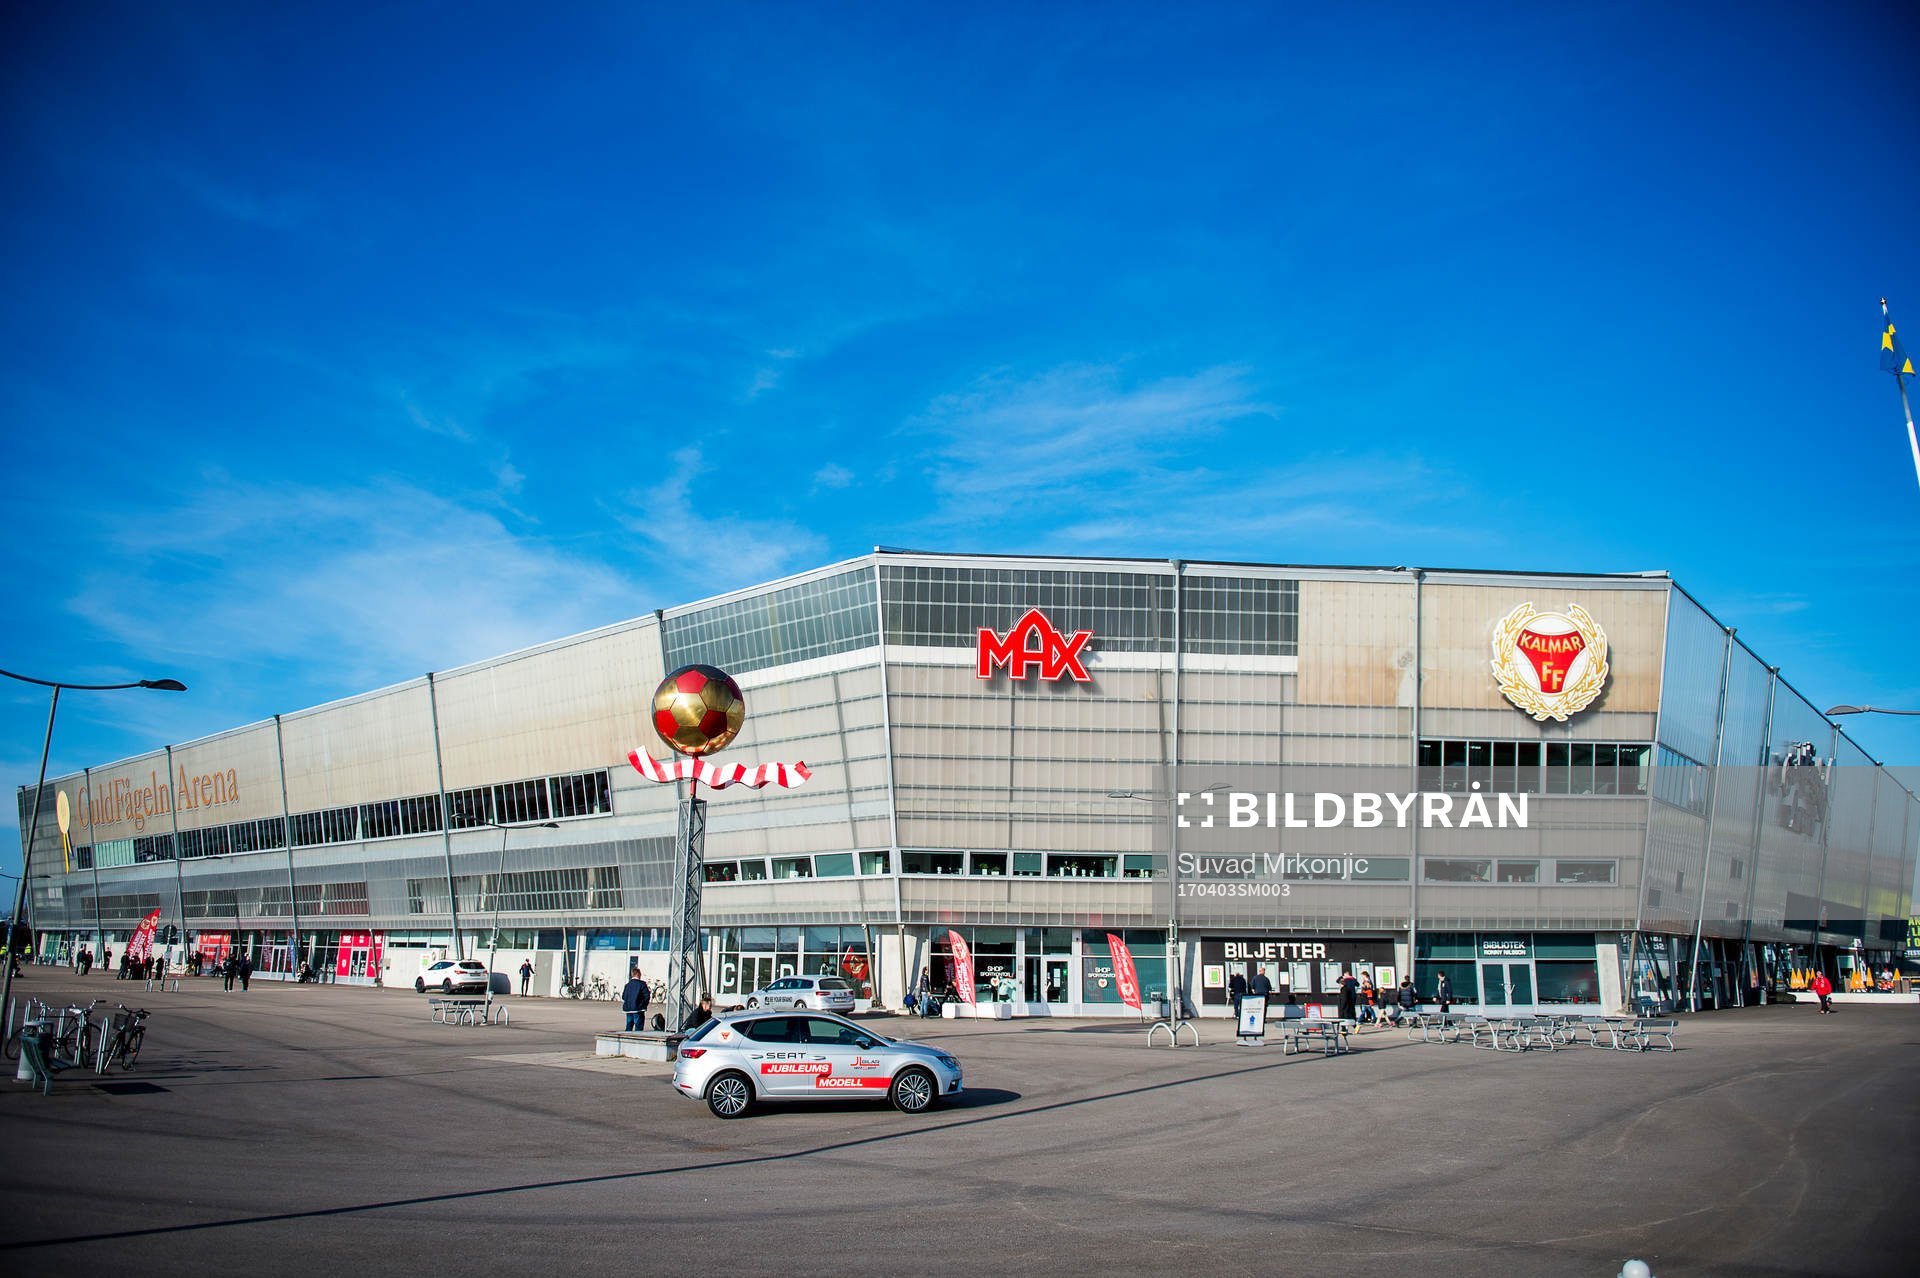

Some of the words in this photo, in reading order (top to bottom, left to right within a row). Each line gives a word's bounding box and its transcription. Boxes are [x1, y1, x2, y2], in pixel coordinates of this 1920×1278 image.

[976, 607, 1094, 682] MAX
[1520, 632, 1583, 653] KALMAR
[175, 763, 239, 811] Arena
[1224, 942, 1327, 959] BILJETTER
[1483, 941, 1526, 949] BIBLIOTEK
[723, 962, 735, 987] C
[767, 1063, 829, 1073] JUBILEUMS
[818, 1078, 864, 1087] MODELL
